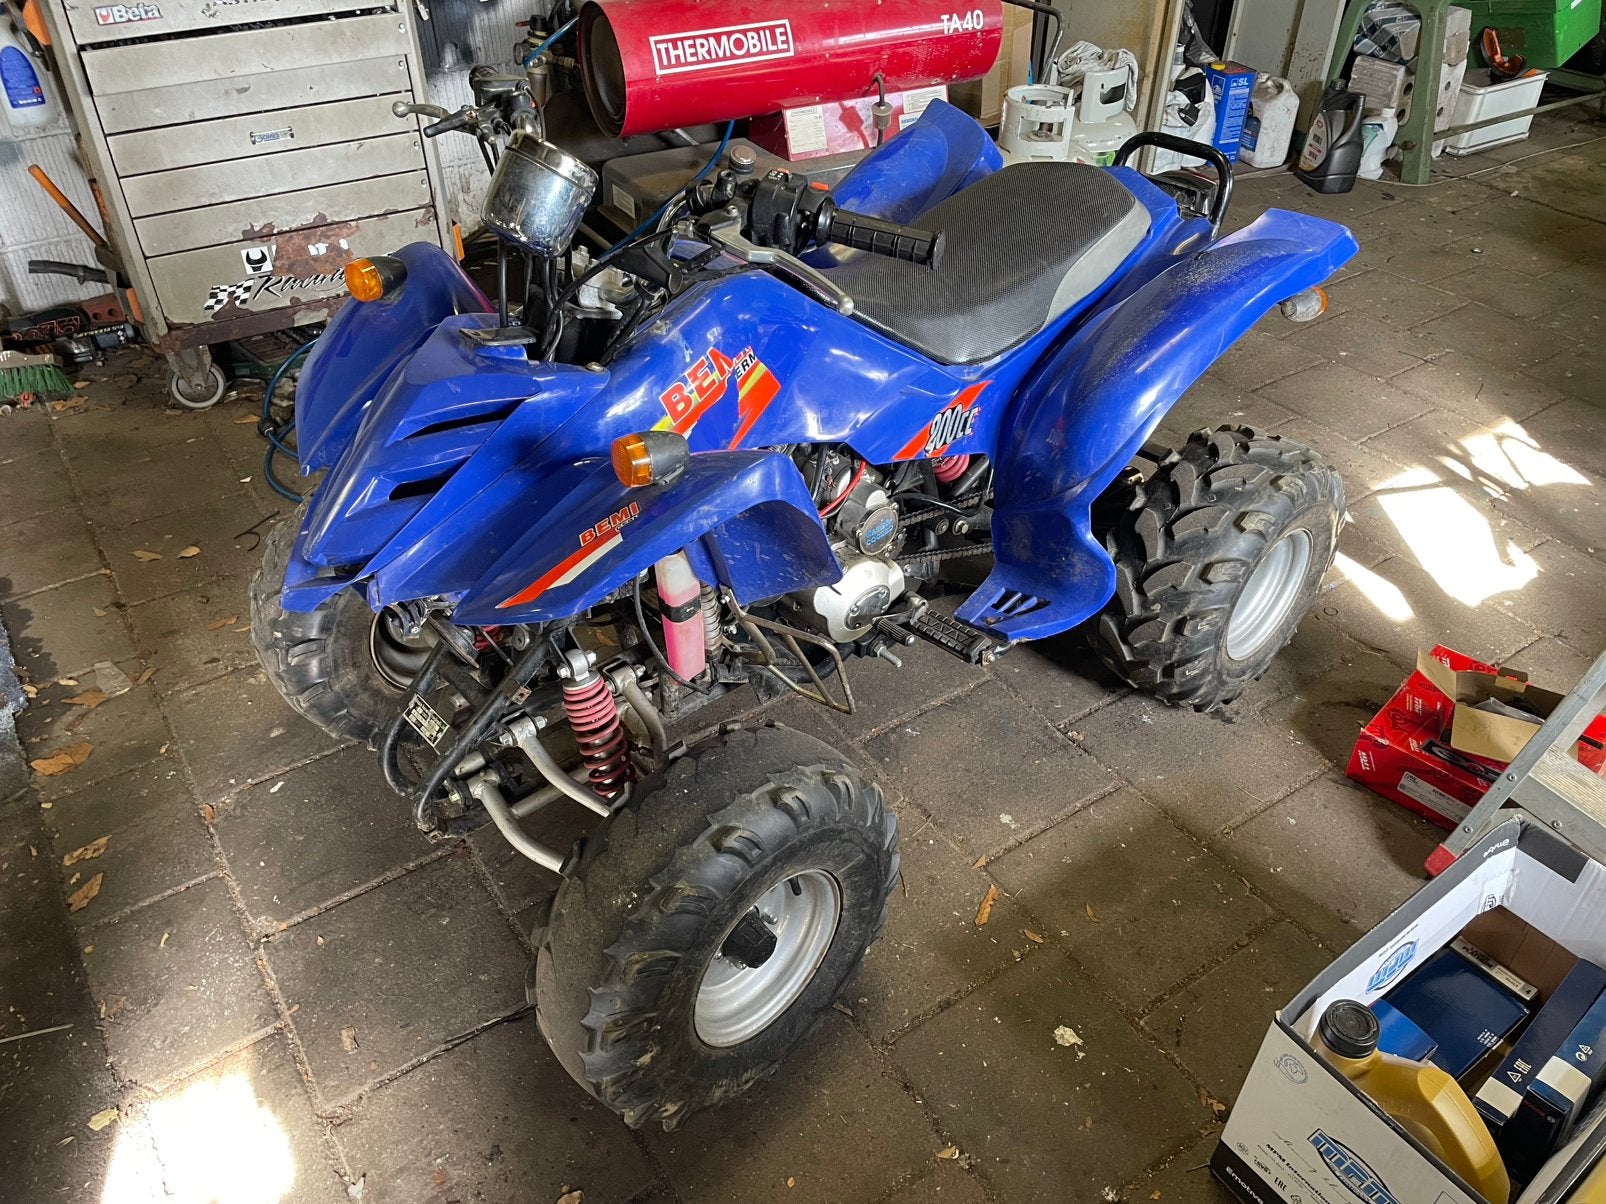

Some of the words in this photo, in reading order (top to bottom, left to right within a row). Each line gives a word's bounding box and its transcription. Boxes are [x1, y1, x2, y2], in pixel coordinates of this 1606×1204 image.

[112, 3, 161, 22] Beta
[656, 26, 788, 66] THERMOBILE
[579, 501, 639, 547] BEMI
[1265, 1142, 1286, 1163] MPM
